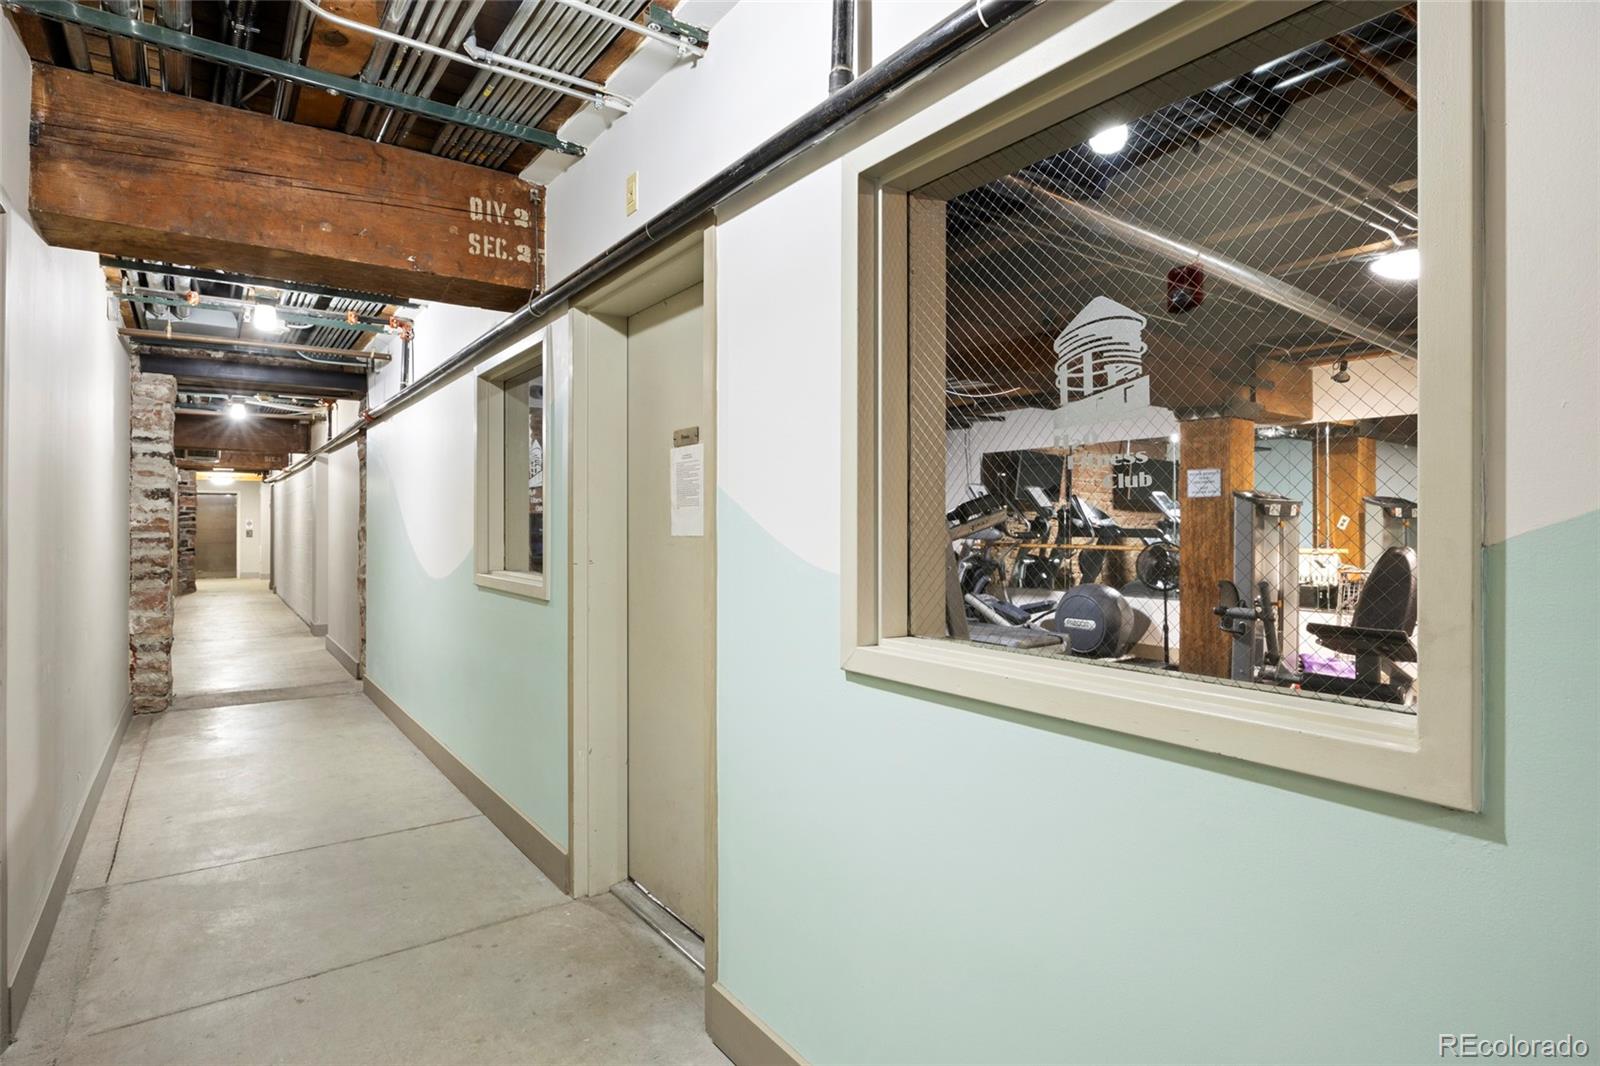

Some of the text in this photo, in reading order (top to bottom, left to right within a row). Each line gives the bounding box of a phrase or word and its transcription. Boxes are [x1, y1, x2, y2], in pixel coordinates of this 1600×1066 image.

[469, 197, 530, 228] DIV. 2
[469, 233, 513, 260] SEC.
[1103, 472, 1153, 489] Club
